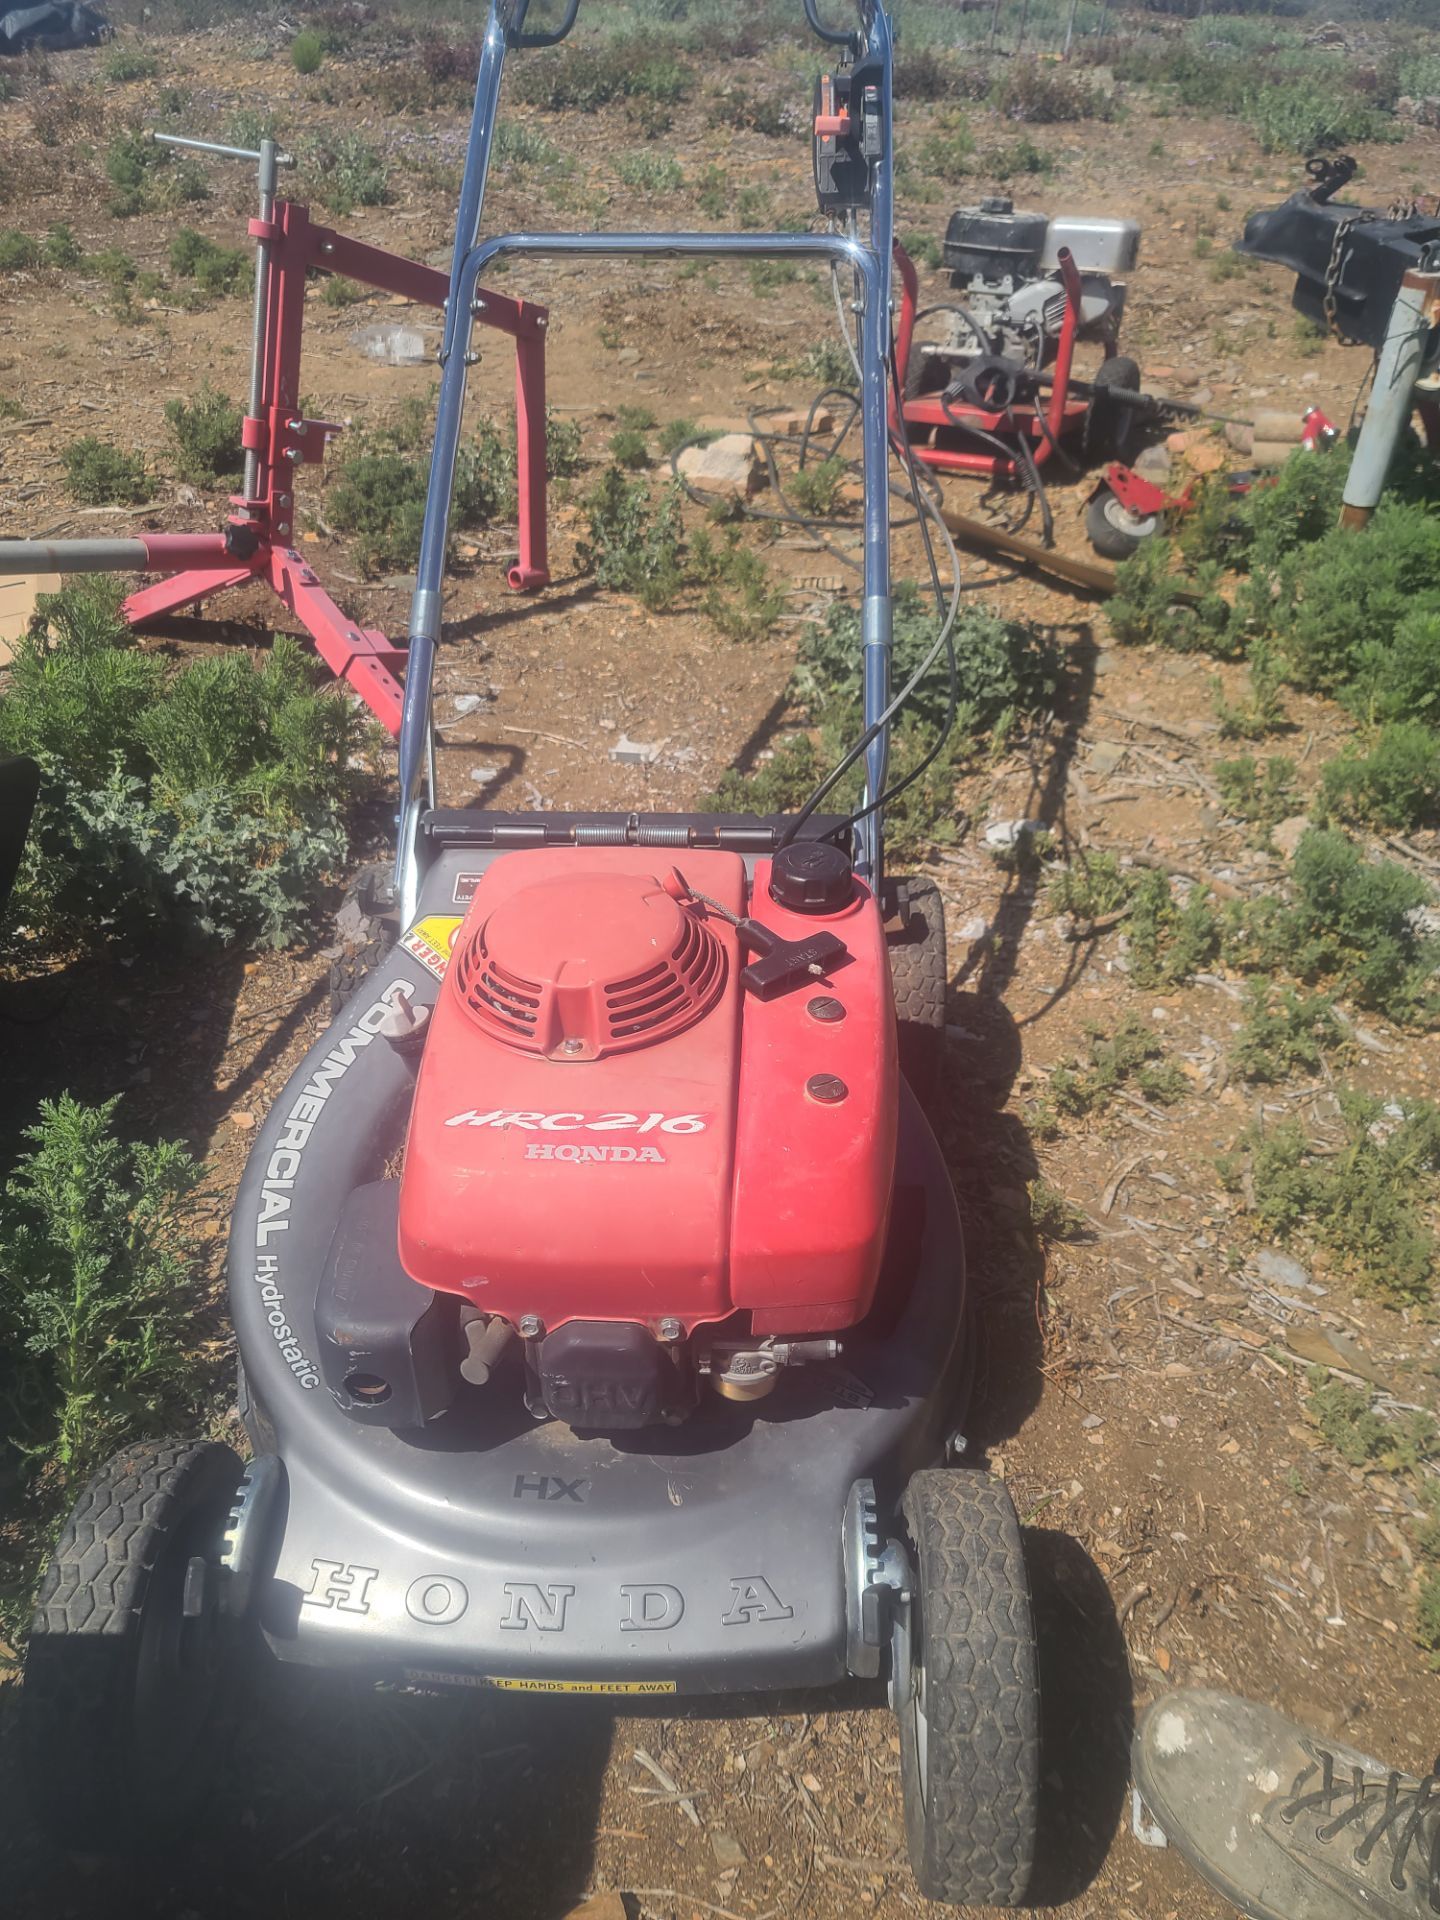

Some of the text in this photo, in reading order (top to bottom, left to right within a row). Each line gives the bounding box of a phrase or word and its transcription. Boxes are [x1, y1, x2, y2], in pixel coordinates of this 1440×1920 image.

[256, 978, 416, 1247] COMMERCIAL
[444, 1110, 709, 1134] HRC216
[524, 1143, 666, 1163] HONDA
[254, 1255, 320, 1389] Hydrostatic
[512, 1474, 587, 1502] HX
[302, 1558, 795, 1632] HONDA
[519, 1681, 564, 1691] HANDS
[570, 1684, 593, 1692] and
[599, 1684, 630, 1692] FEET
[637, 1683, 672, 1692] AWAY
